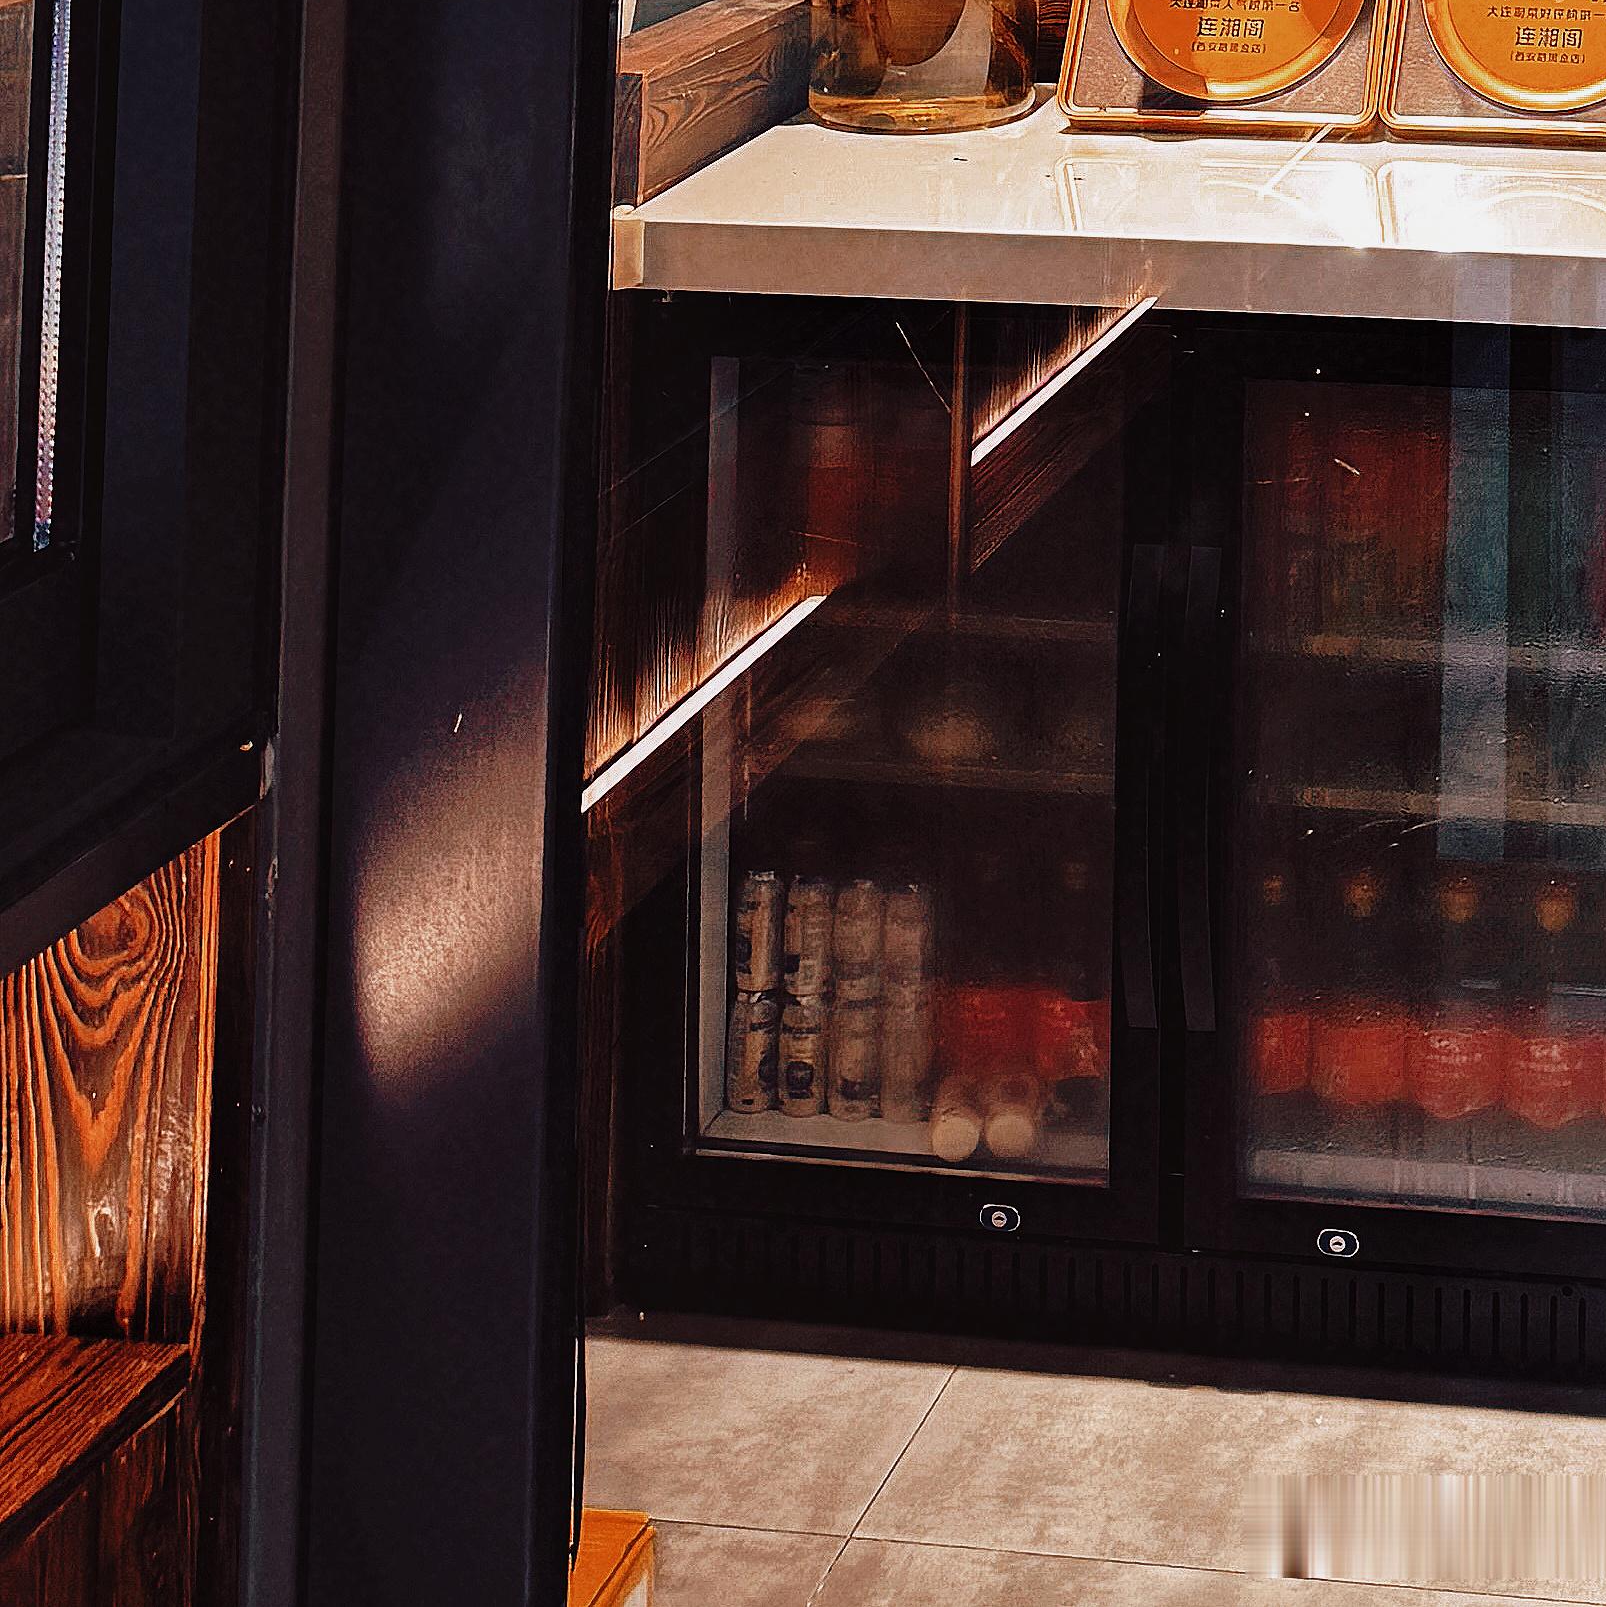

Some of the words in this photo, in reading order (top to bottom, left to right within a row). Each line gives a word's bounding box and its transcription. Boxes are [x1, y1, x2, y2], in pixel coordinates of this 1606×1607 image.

[1196, 17, 1265, 39] 连湘阁
[1515, 26, 1583, 48] 连湘阁
